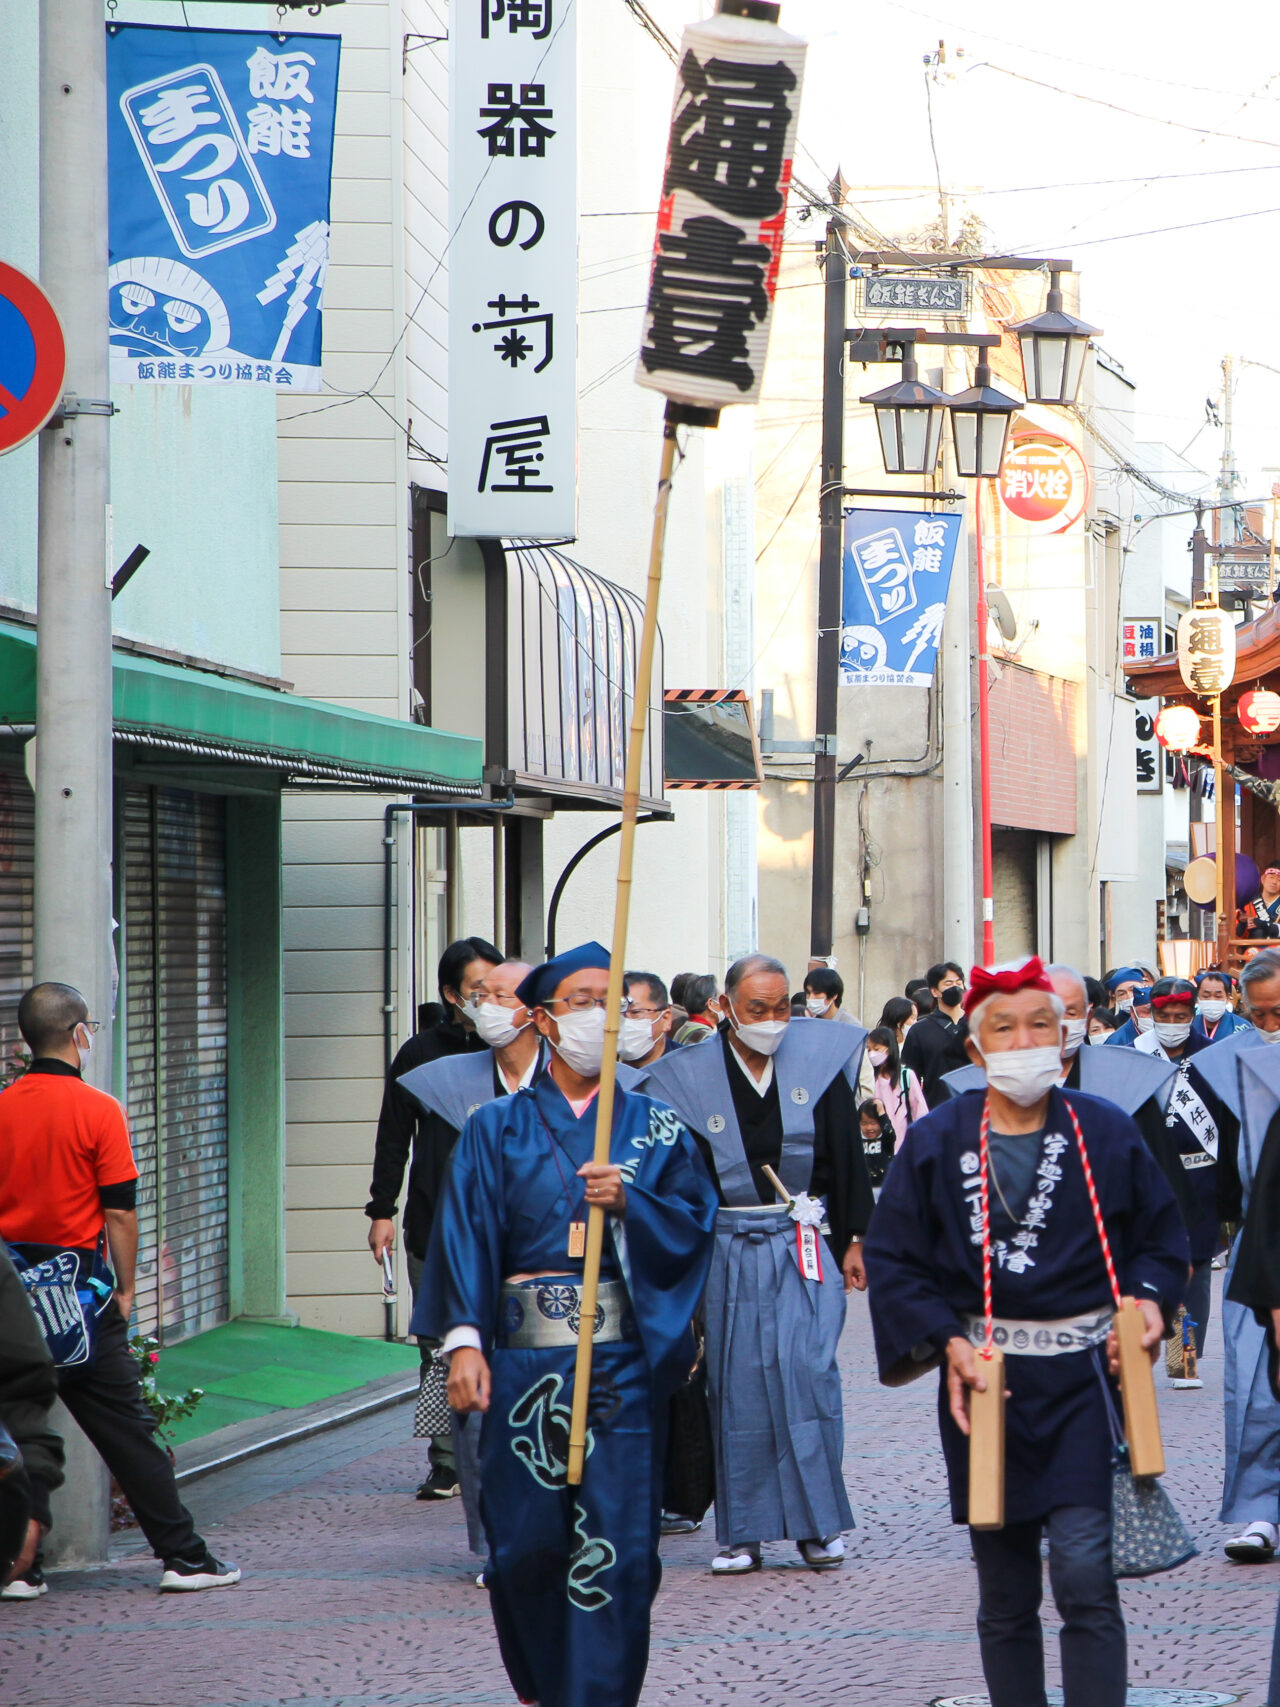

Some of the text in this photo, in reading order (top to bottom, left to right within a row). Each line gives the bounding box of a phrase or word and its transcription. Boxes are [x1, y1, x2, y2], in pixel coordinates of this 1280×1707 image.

[246, 46, 317, 159] 飯能
[140, 84, 250, 234] まつり
[472, 0, 557, 494] 陶器の菊屋
[137, 360, 294, 386] 飯能まつり協賛会
[1004, 468, 1070, 500] 消火栓
[858, 539, 907, 615] まつり
[912, 518, 947, 574] 飯能
[1175, 1088, 1217, 1146] 責任者
